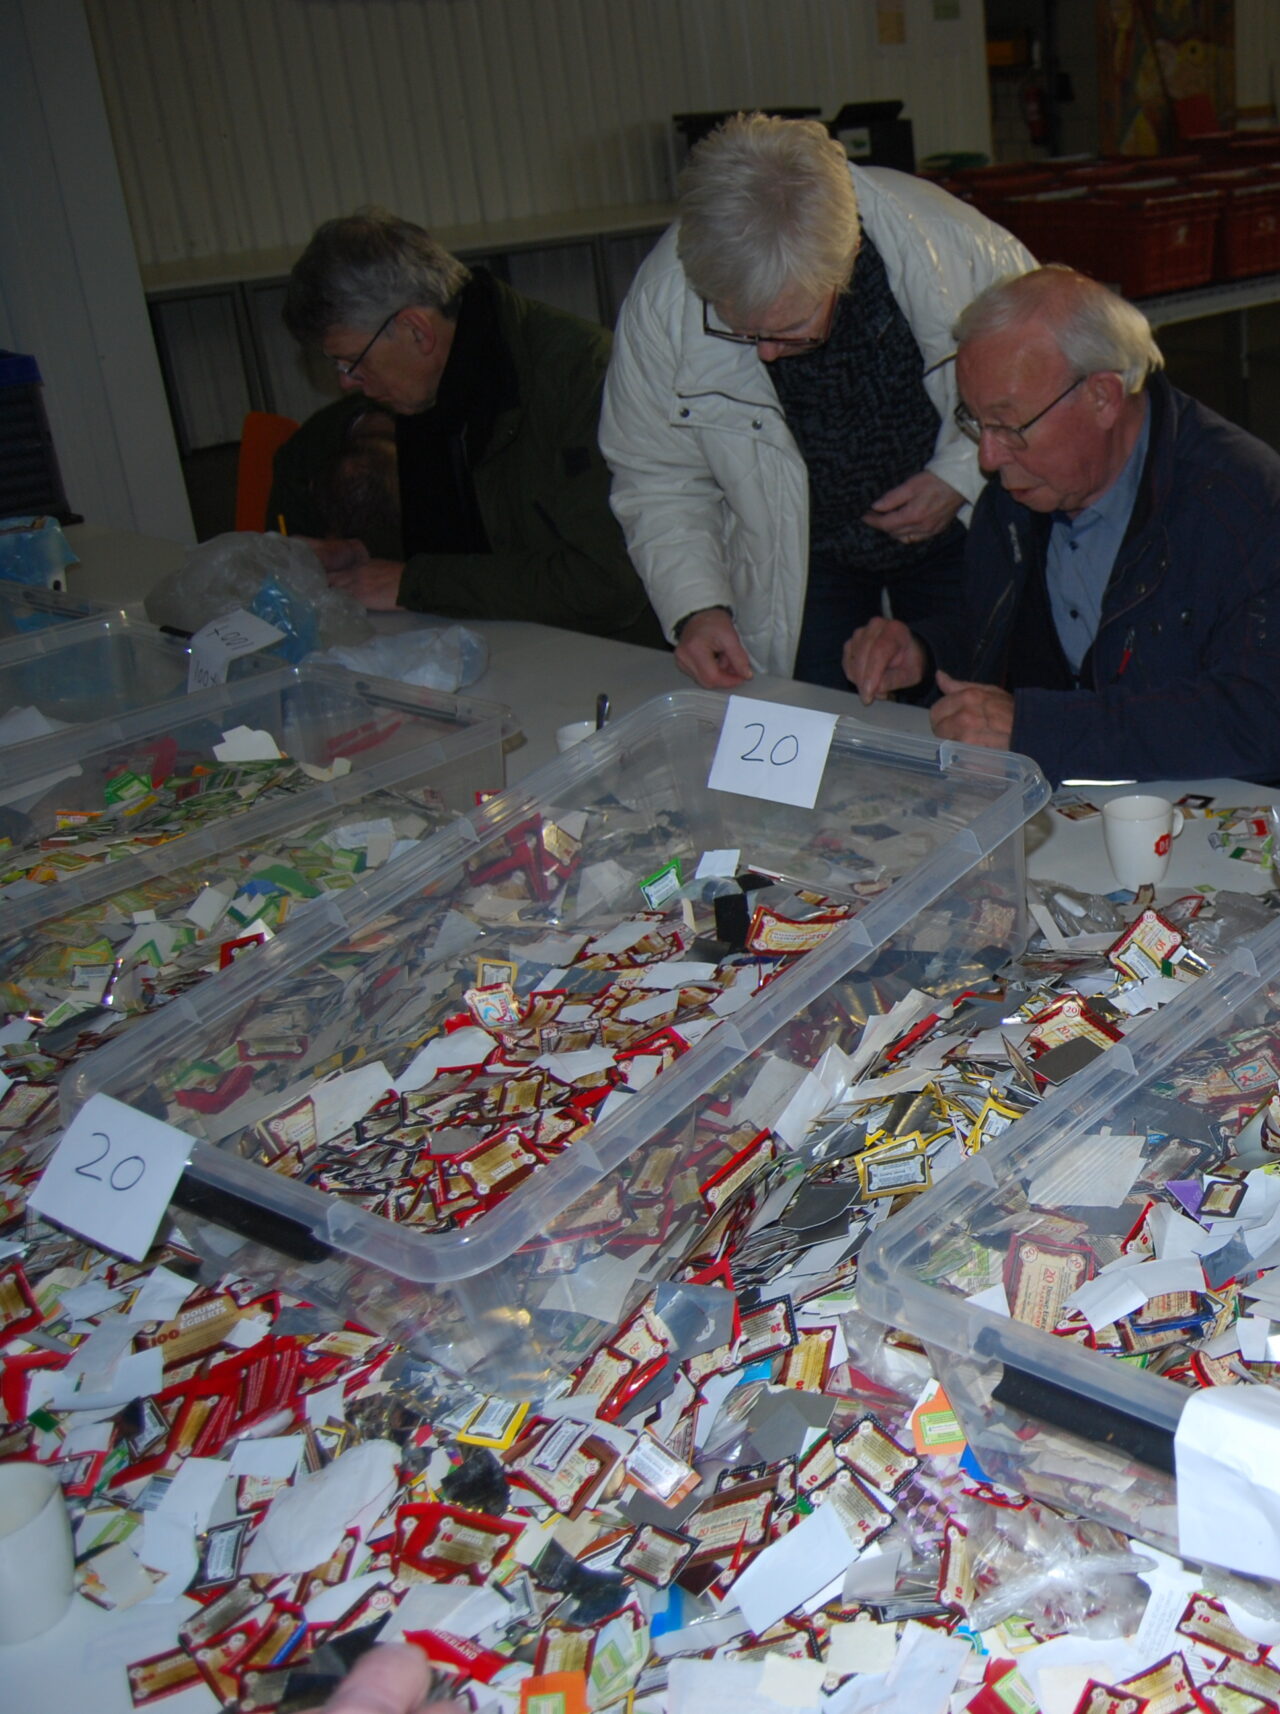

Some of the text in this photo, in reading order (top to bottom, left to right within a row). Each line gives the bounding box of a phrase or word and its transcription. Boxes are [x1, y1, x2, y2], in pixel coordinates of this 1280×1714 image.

[741, 723, 799, 766] 20
[1156, 940, 1166, 950] 10
[1066, 1006, 1078, 1014] 20
[511, 1150, 523, 1159] 20
[75, 1132, 146, 1191] 20
[1139, 1234, 1148, 1245] 10
[1024, 1248, 1035, 1257] 20
[1043, 1267, 1055, 1284] 20
[181, 1298, 225, 1322] DOUWE
[179, 1304, 228, 1330] EGBERTS
[770, 1323, 782, 1334] 20
[151, 1329, 180, 1347] 100
[885, 1465, 899, 1475] 20
[806, 1475, 818, 1487] 10
[857, 1520, 870, 1533] 20
[441, 1533, 453, 1543] 10
[955, 1587, 963, 1599] 10
[374, 1596, 389, 1605] 20
[1197, 1615, 1210, 1623] 10
[1174, 1680, 1186, 1692] 20
